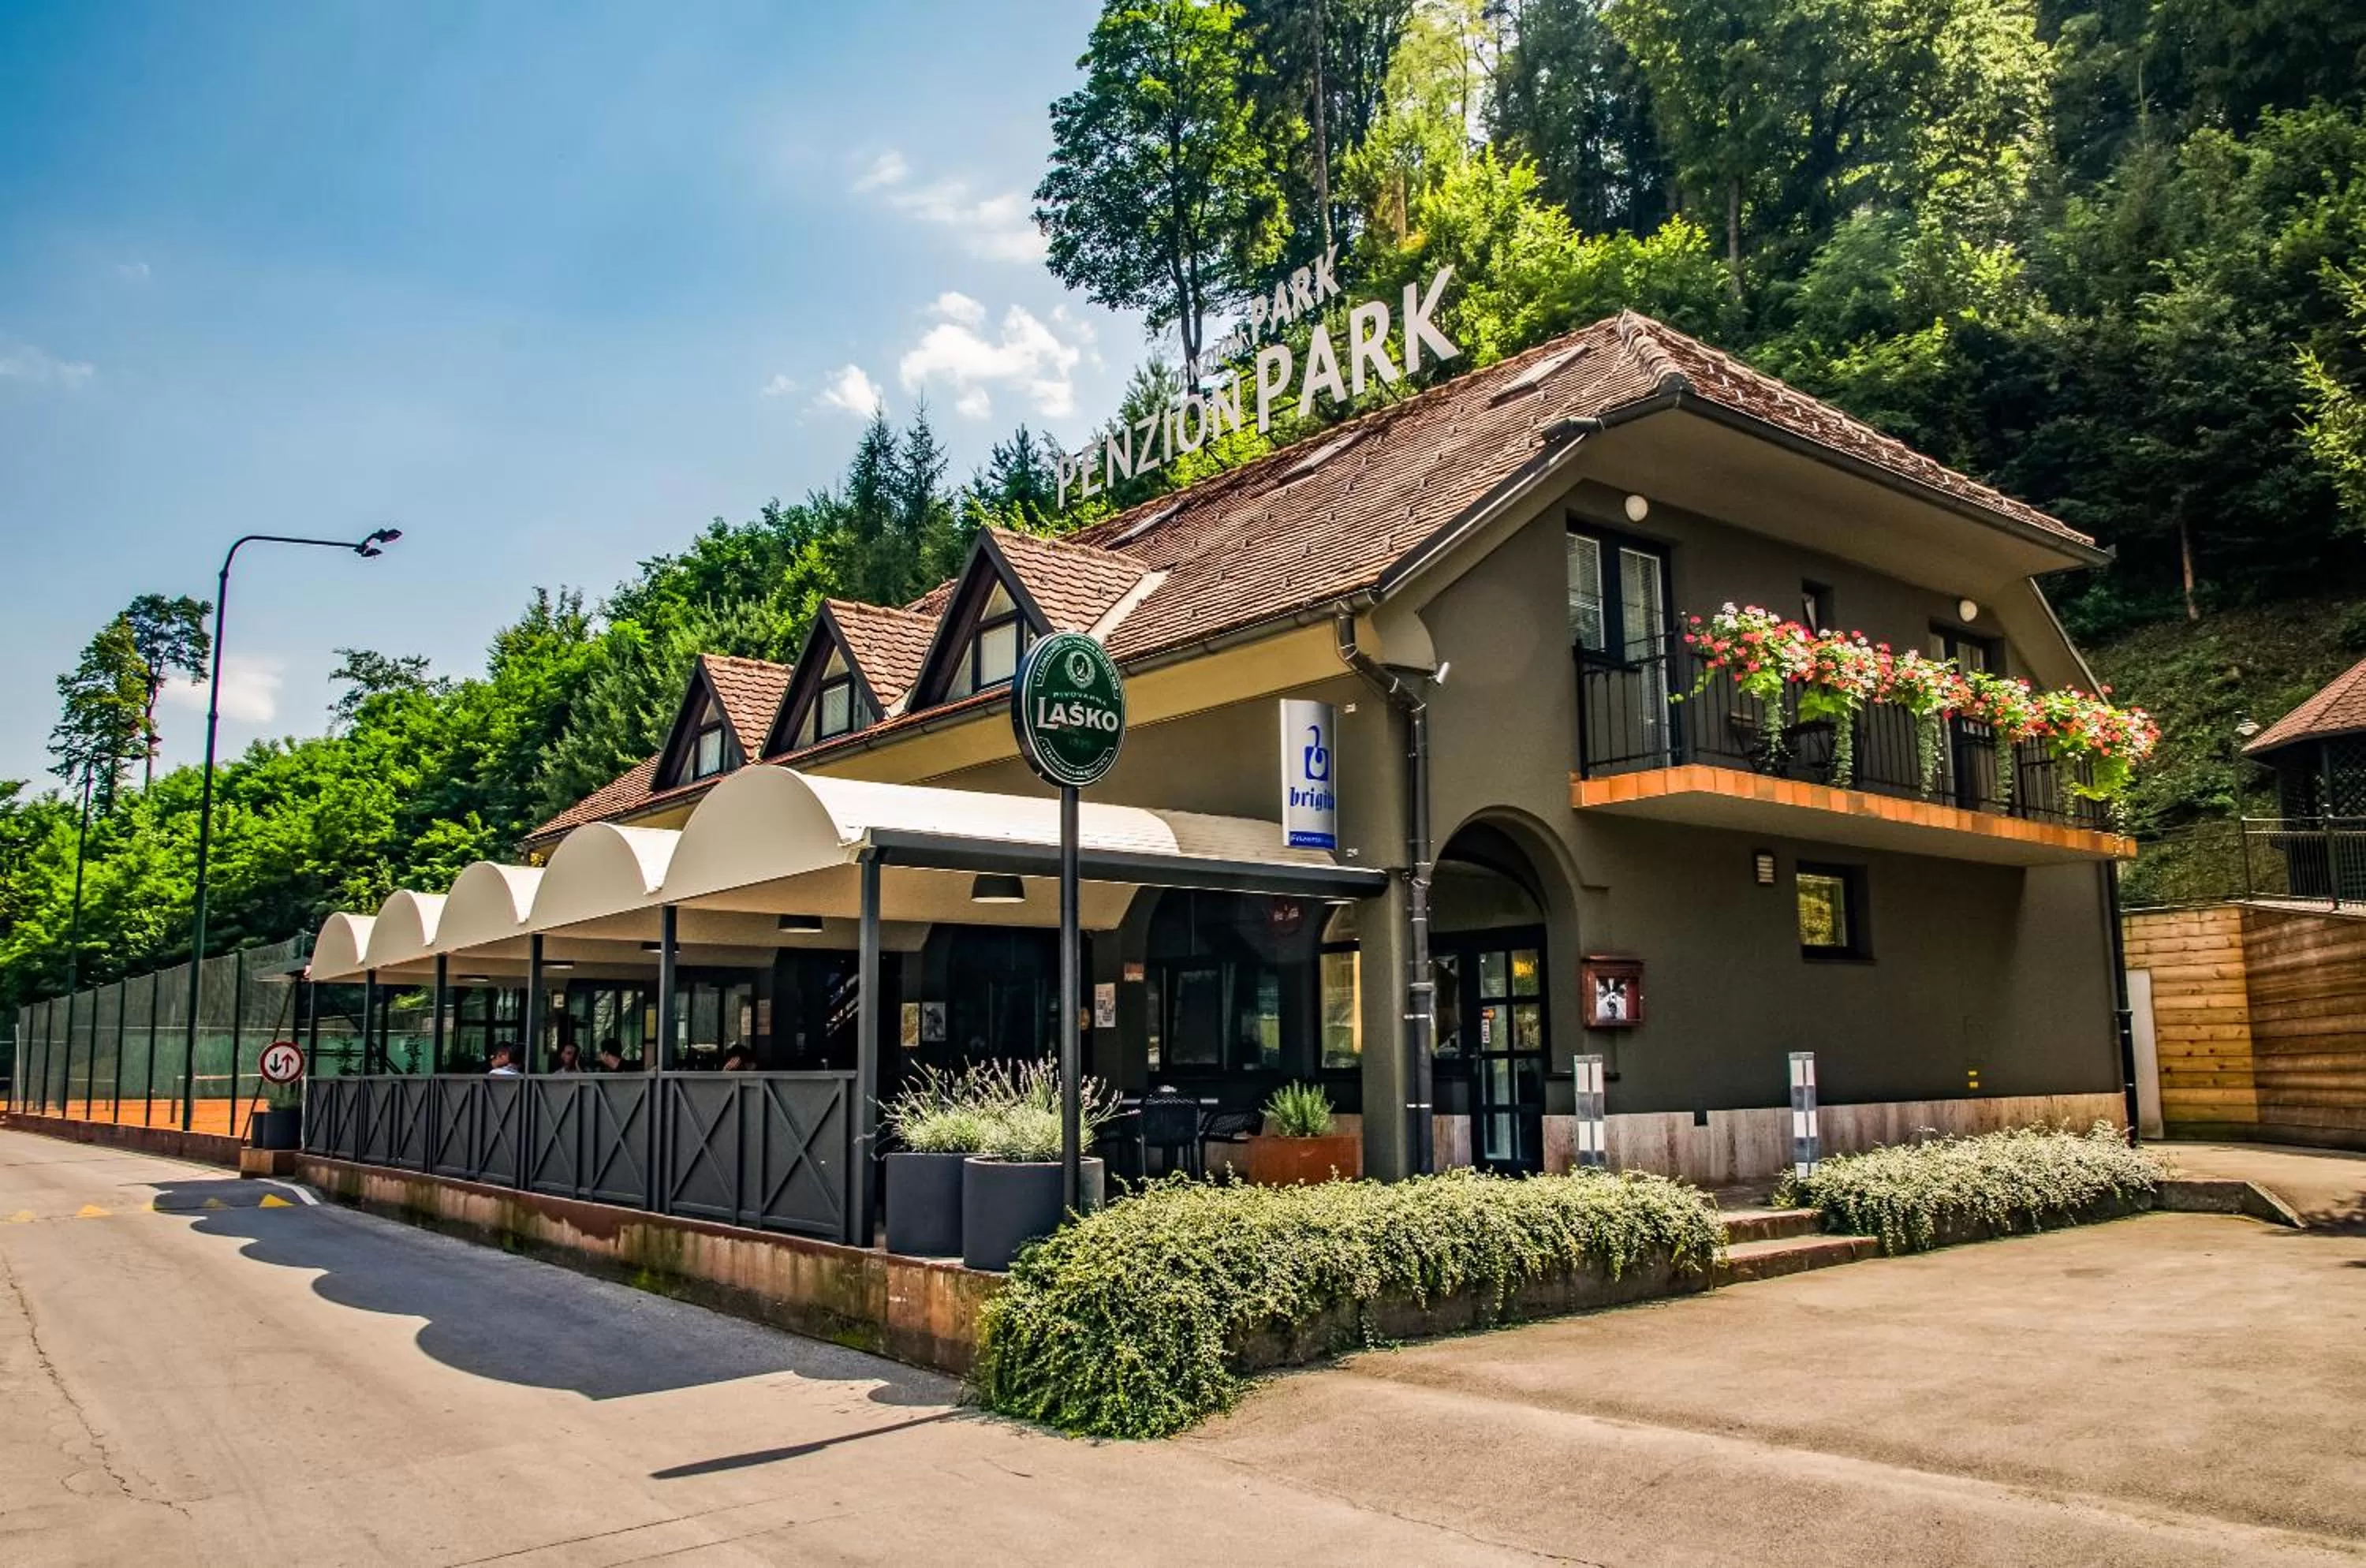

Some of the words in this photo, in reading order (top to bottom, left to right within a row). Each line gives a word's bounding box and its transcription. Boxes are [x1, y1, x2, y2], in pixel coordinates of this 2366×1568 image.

[1251, 243, 1342, 345] PARK
[1057, 374, 1241, 510] PENZION
[1256, 264, 1461, 434] PARK
[1036, 696, 1120, 733] LAŠKO
